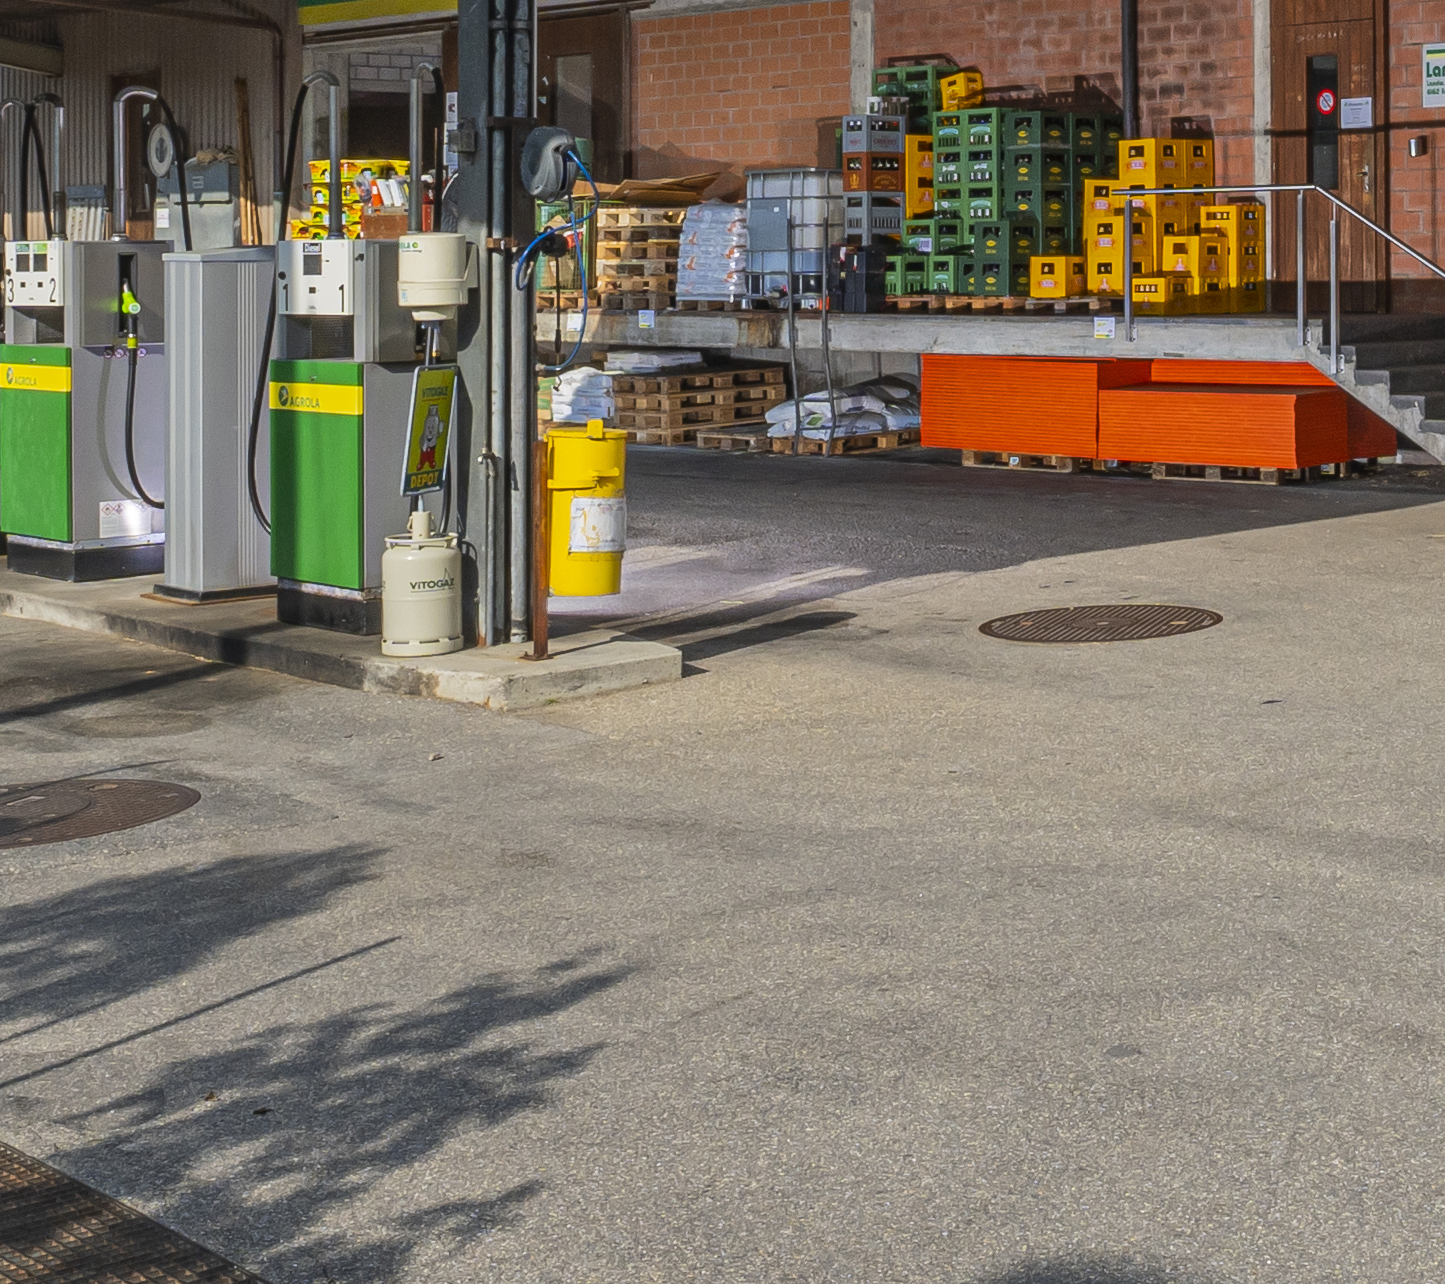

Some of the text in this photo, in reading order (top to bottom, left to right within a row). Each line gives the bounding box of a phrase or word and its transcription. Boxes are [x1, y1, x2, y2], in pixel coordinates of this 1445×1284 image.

[7, 278, 15, 303] 3
[49, 277, 57, 303] 2
[282, 283, 289, 312] 1
[338, 283, 345, 313] 1
[288, 395, 320, 409] AGROLA
[410, 472, 440, 489] DEPOT
